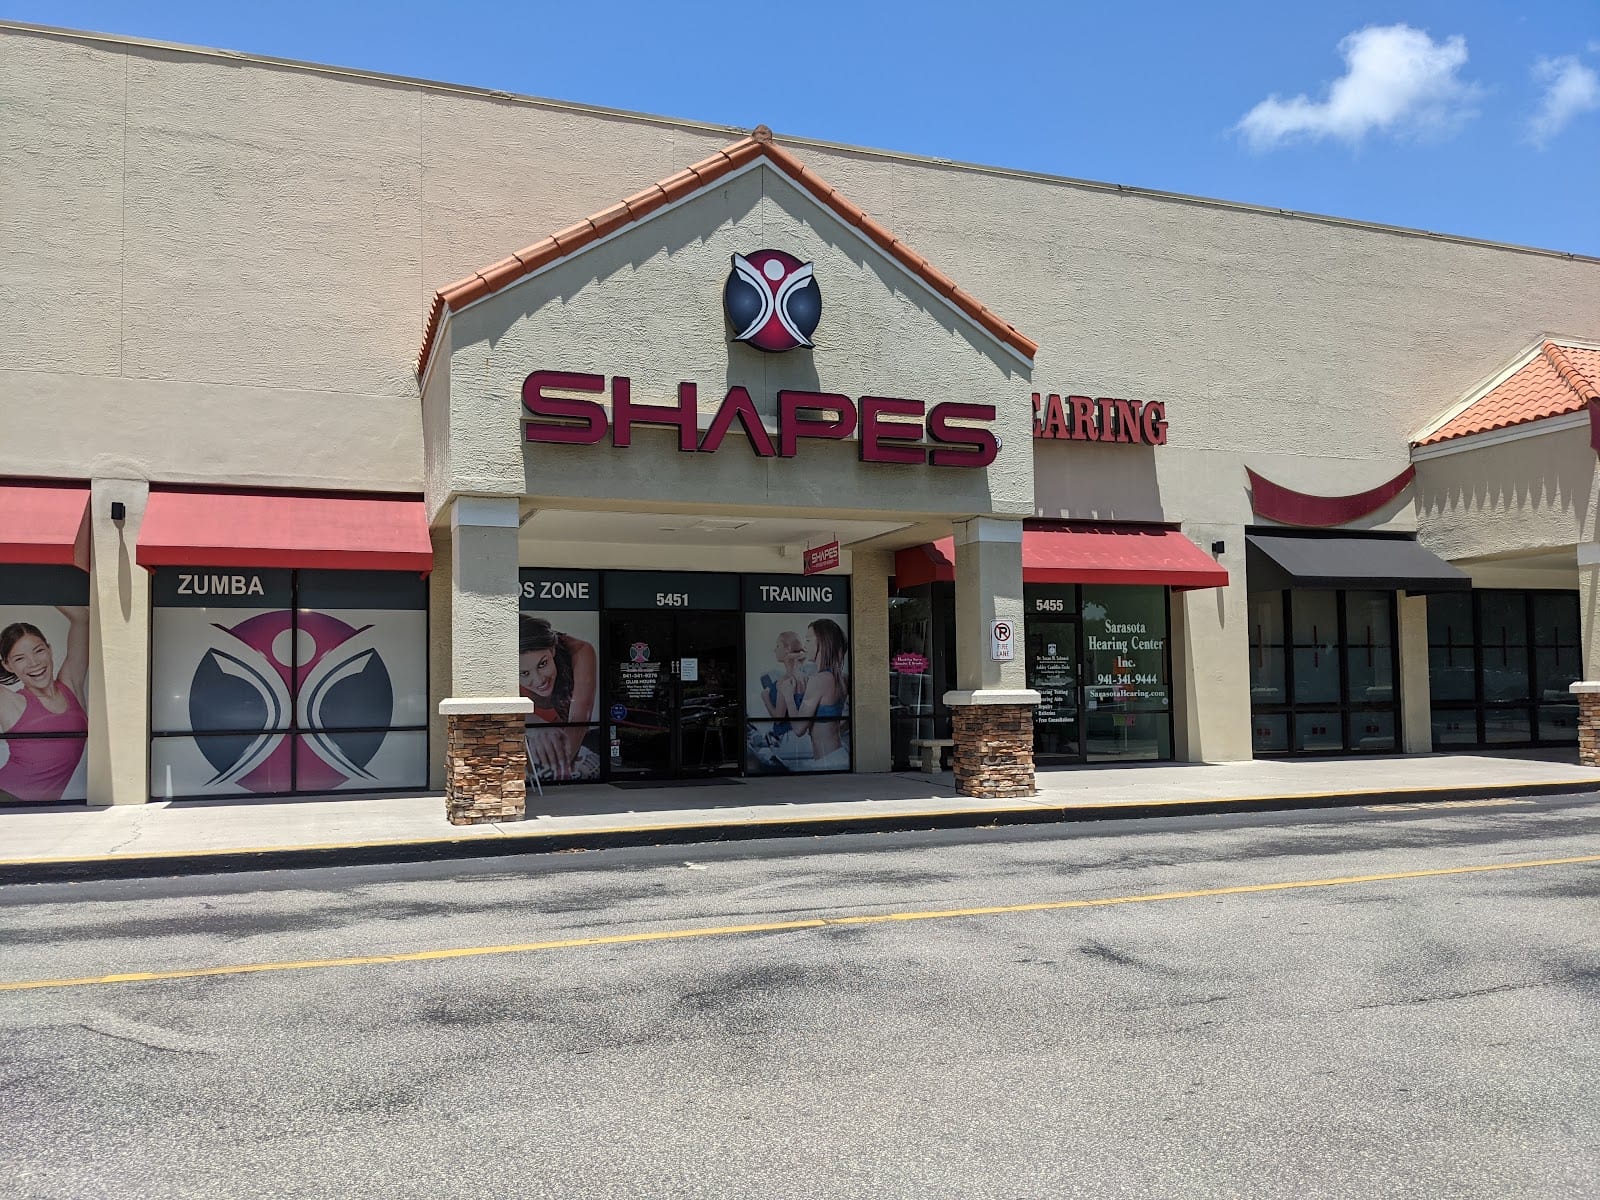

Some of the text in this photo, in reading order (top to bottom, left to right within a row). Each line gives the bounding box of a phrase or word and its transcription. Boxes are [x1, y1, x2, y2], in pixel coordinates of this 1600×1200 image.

[522, 370, 998, 467] SHAPES
[811, 546, 838, 564] SHAPES
[177, 574, 265, 595] ZUMBA
[540, 581, 590, 599] ZONE
[656, 593, 689, 607] 5451
[759, 585, 833, 602] TRAINING
[1036, 599, 1064, 611] 5455
[1105, 619, 1146, 634] Sarasota
[1088, 635, 1163, 654] Hearing Center
[1117, 655, 1136, 668] Inc.
[1097, 673, 1158, 685] 941-341-9444
[1089, 689, 1165, 698] SarasotaHearing.com
